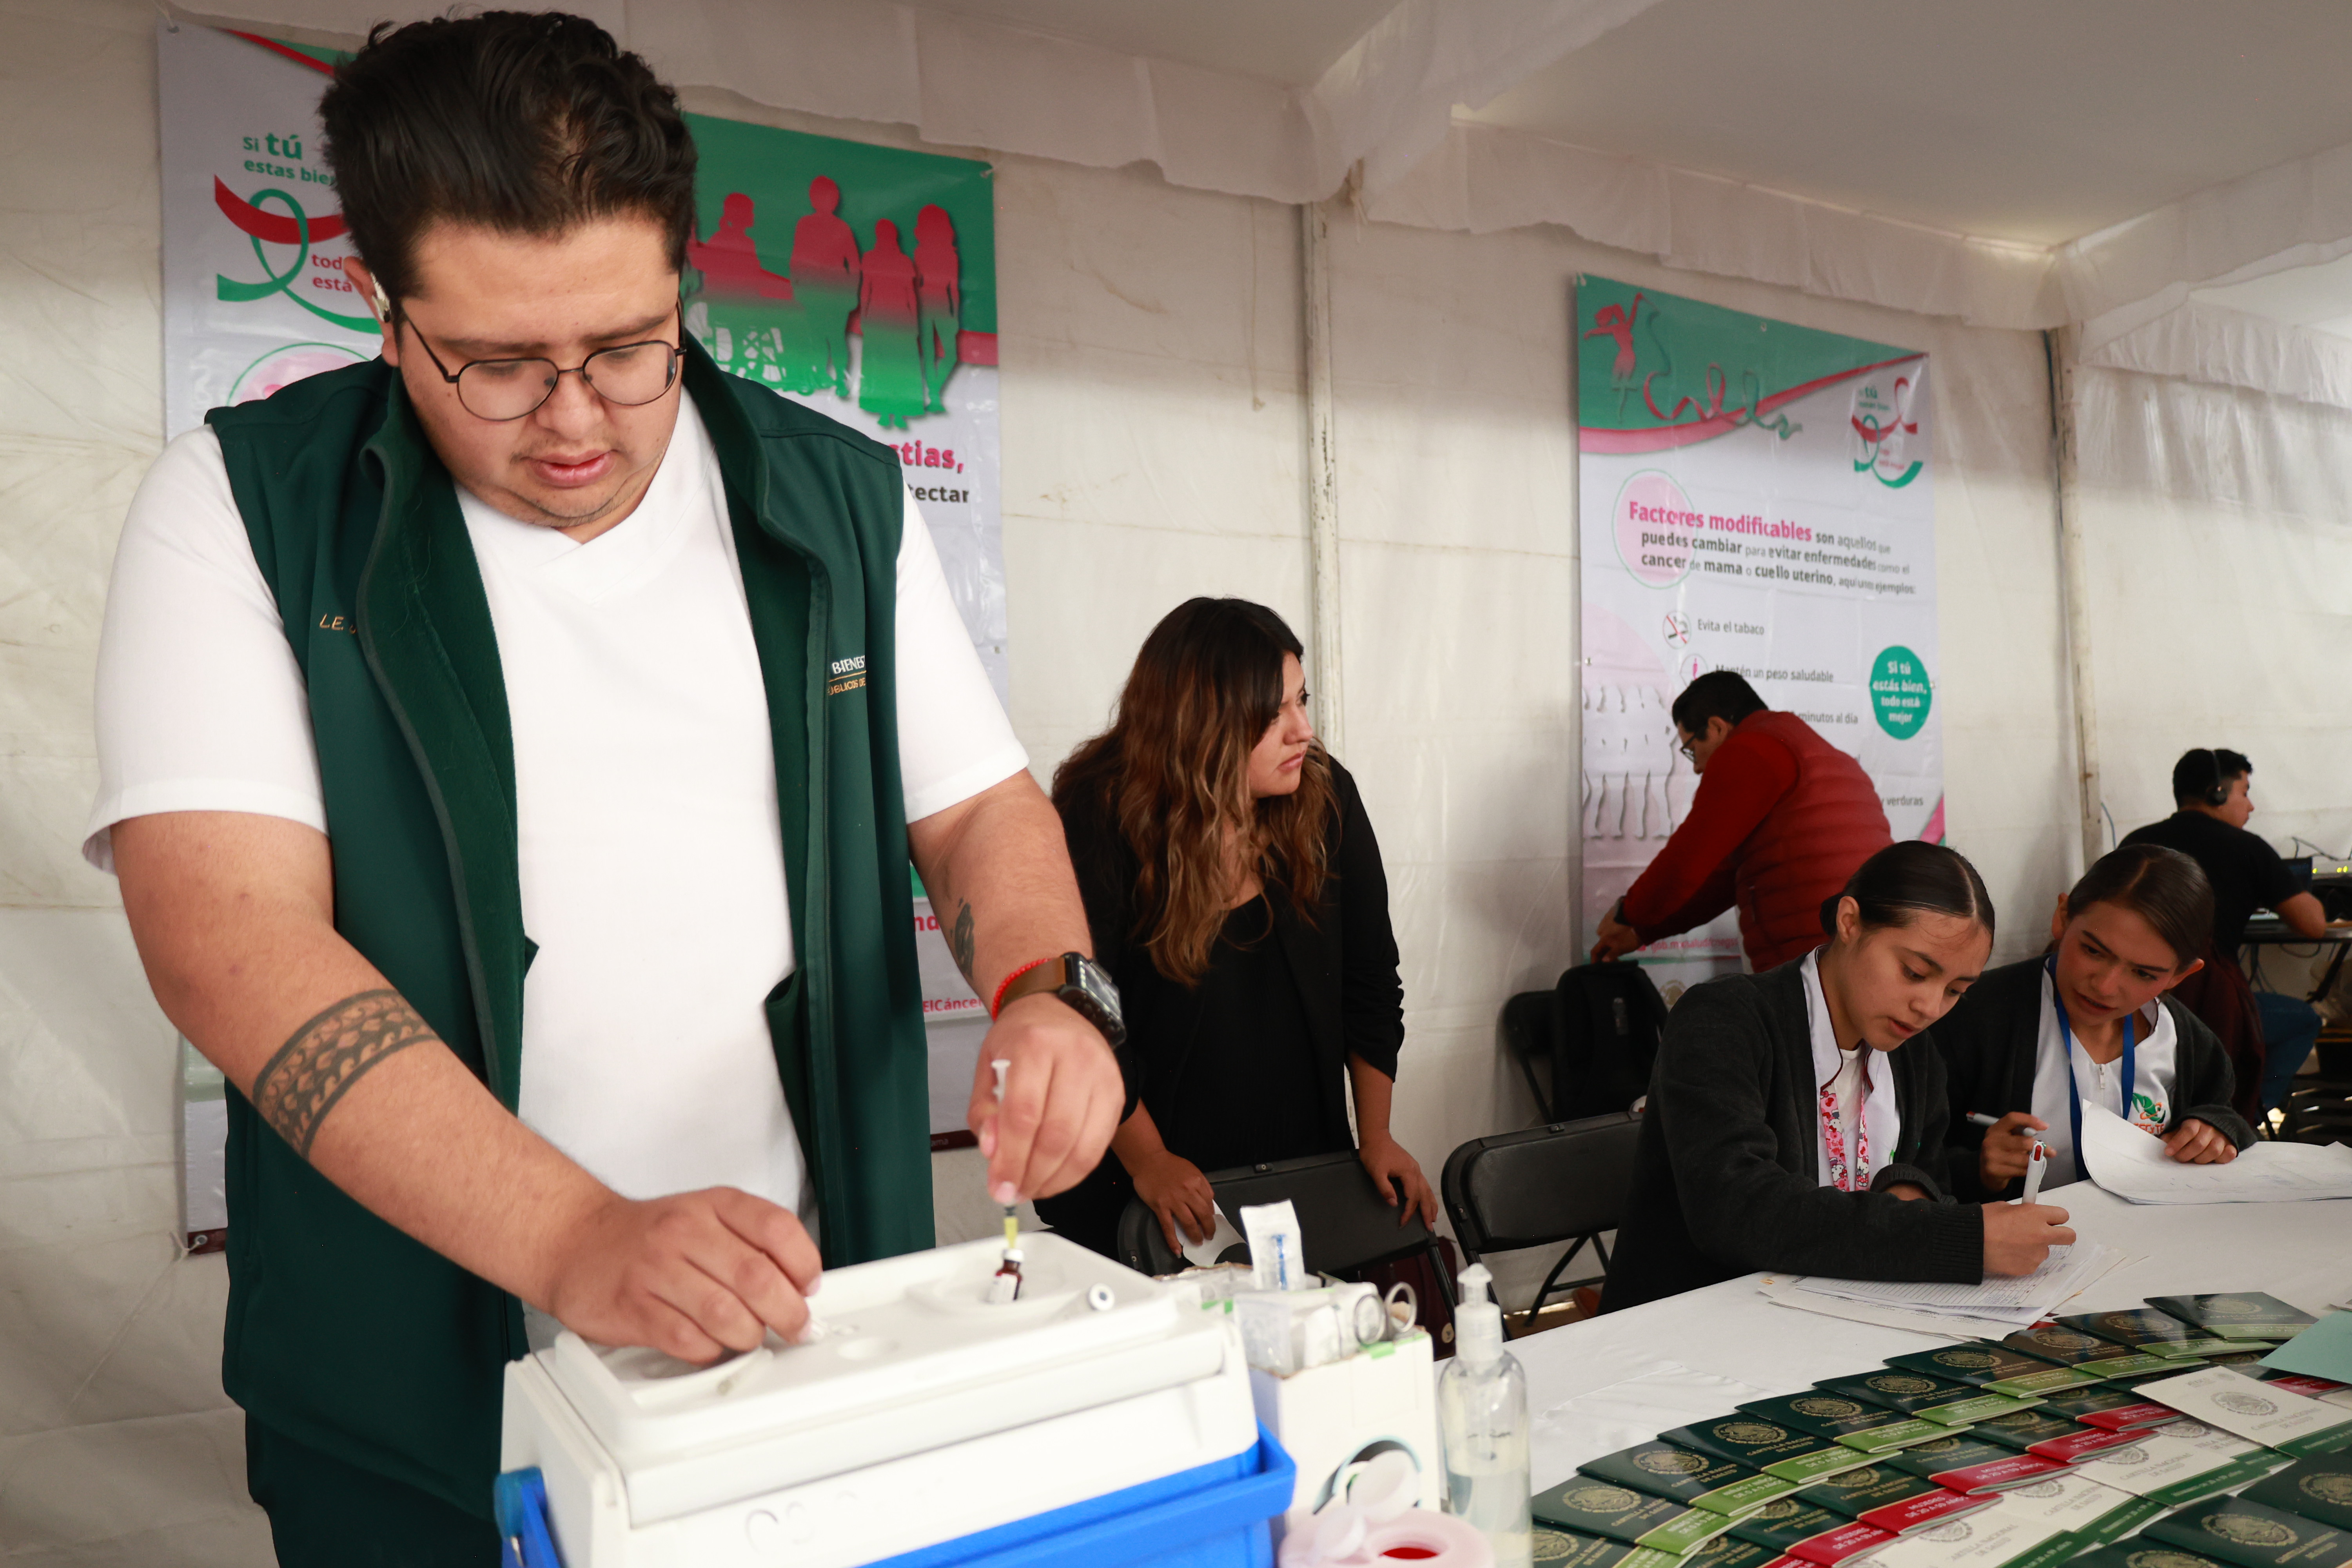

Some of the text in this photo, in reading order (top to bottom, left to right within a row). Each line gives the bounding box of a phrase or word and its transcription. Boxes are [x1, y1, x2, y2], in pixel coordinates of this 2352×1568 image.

[265, 132, 302, 160] tú
[244, 160, 336, 185] estas bie
[311, 254, 343, 270] tod
[1630, 501, 1704, 528] Factores
[1710, 515, 1812, 541] modificables
[1816, 532, 1835, 545] son
[1641, 531, 1688, 547] puedes
[1692, 537, 1742, 554] cambiar
[1746, 546, 1766, 557] para
[1769, 547, 1802, 561] evitar
[1804, 550, 1877, 570] enfermedades
[1641, 554, 1686, 568] cancer
[1704, 560, 1743, 575] mama
[1755, 564, 1790, 580] cuello
[1793, 569, 1836, 586] uterino,
[1698, 619, 1765, 636] Evita el tabaco
[1753, 668, 1764, 678] un
[1766, 669, 1788, 681] peso
[1791, 669, 1834, 682] saludable
[1887, 795, 1924, 806] verduras
